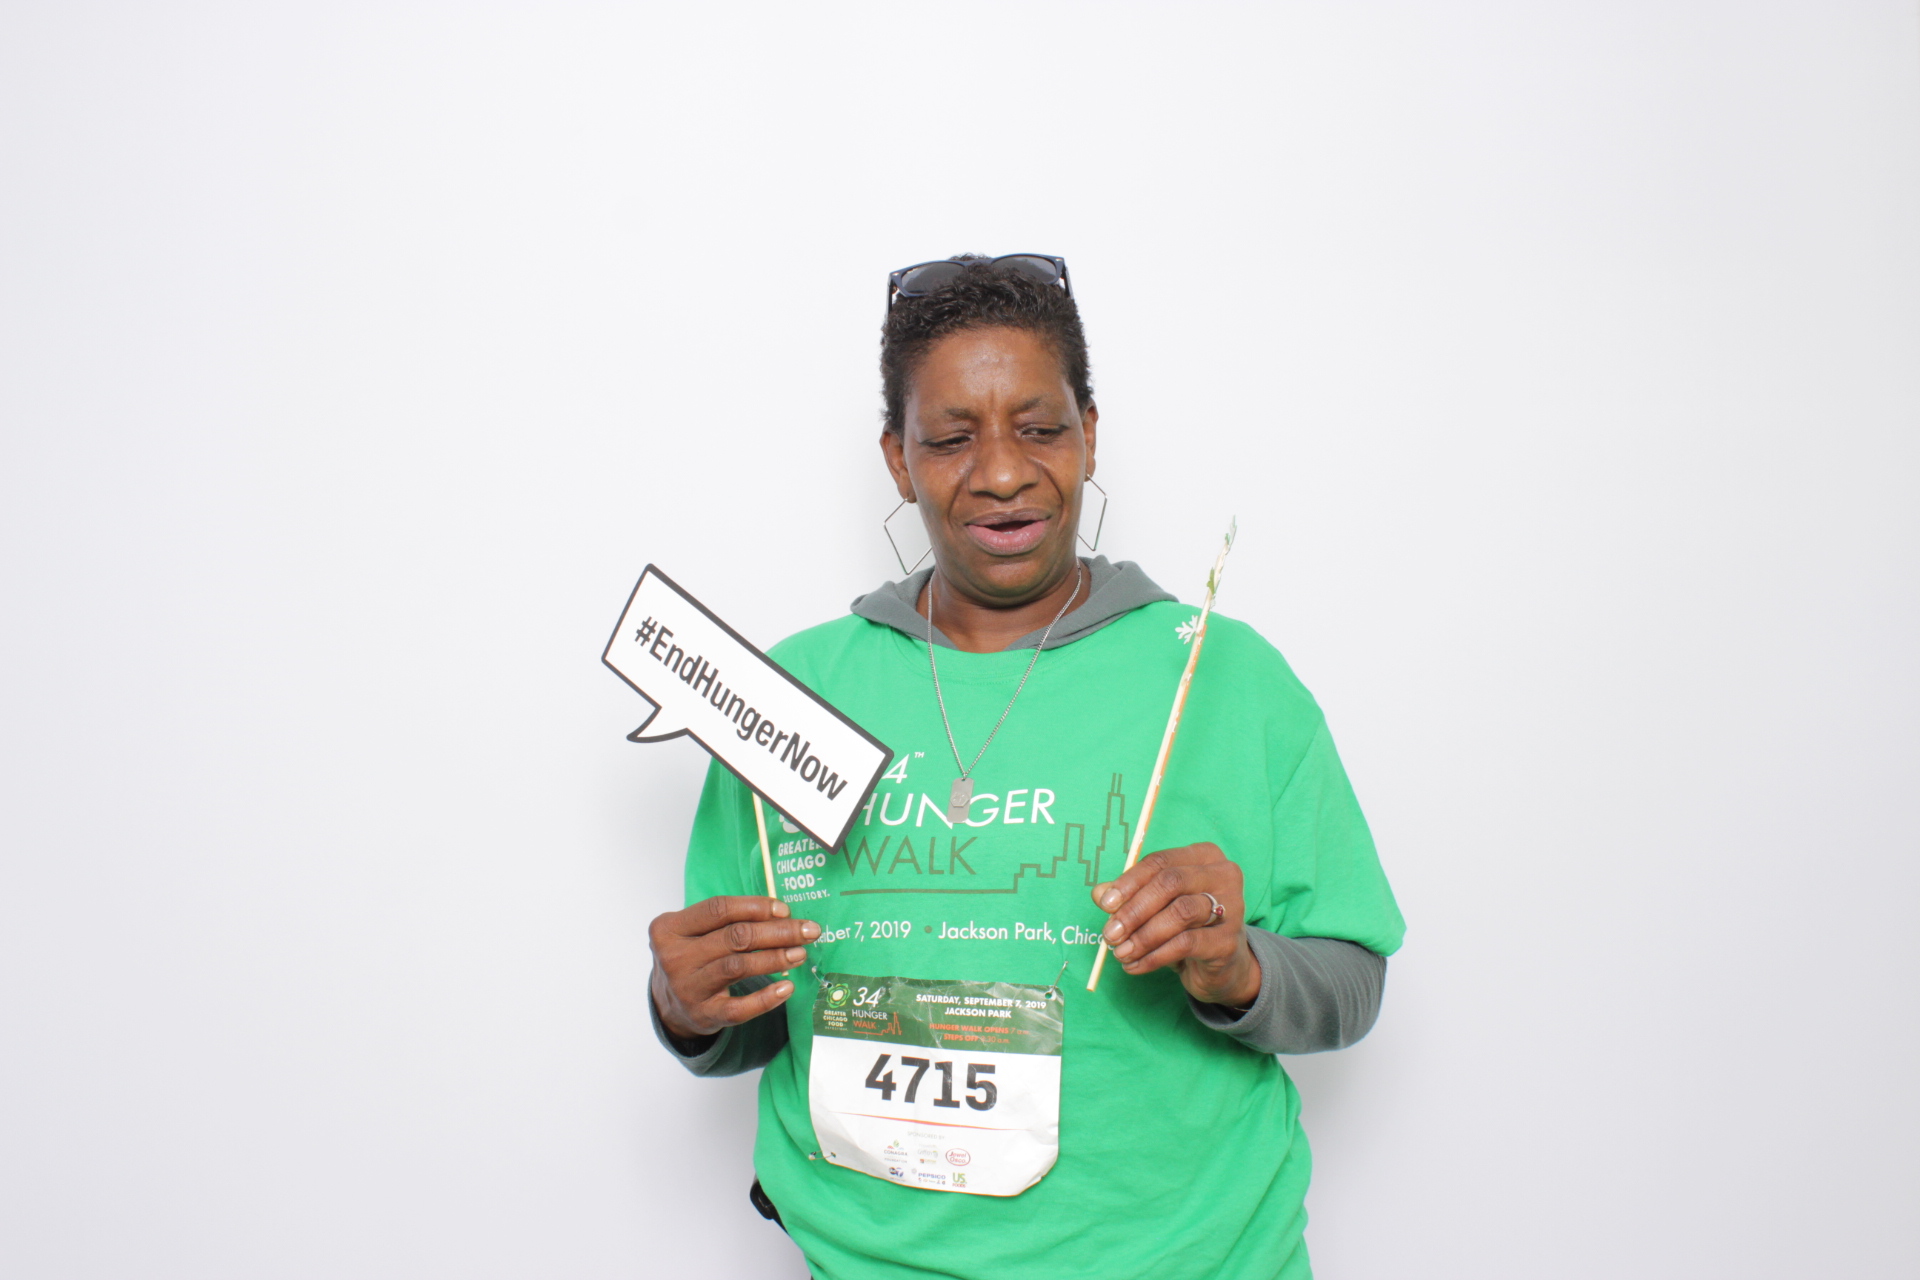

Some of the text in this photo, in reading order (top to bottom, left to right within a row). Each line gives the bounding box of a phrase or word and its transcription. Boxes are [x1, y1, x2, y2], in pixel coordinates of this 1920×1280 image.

[634, 616, 847, 801] #EndHungerNow
[842, 834, 979, 876] WALK
[776, 853, 826, 874] CHICAGO
[854, 921, 865, 942] 7,
[869, 920, 912, 938] 2019
[938, 920, 1008, 940] Jackson
[1014, 921, 1057, 944] Park,
[916, 993, 961, 1006] SATURDAY,
[964, 996, 1013, 1008] SEPTEMBER
[1025, 1000, 1047, 1010] 2019
[823, 1015, 848, 1023] CHICAGO
[824, 1009, 847, 1017] GREATER
[852, 1008, 888, 1020] HUNGER
[944, 1006, 1012, 1019] JACKSON PARK
[853, 1020, 877, 1030] WALK
[929, 1022, 960, 1032] HUNGER
[961, 1024, 983, 1033] WALK
[984, 1025, 1009, 1035] OPENS
[943, 1032, 964, 1042] STEPS
[964, 1034, 980, 1042] OFF
[865, 1053, 998, 1112] 4715
[949, 1150, 967, 1159] Jewel
[918, 1172, 946, 1180] PEPSICO
